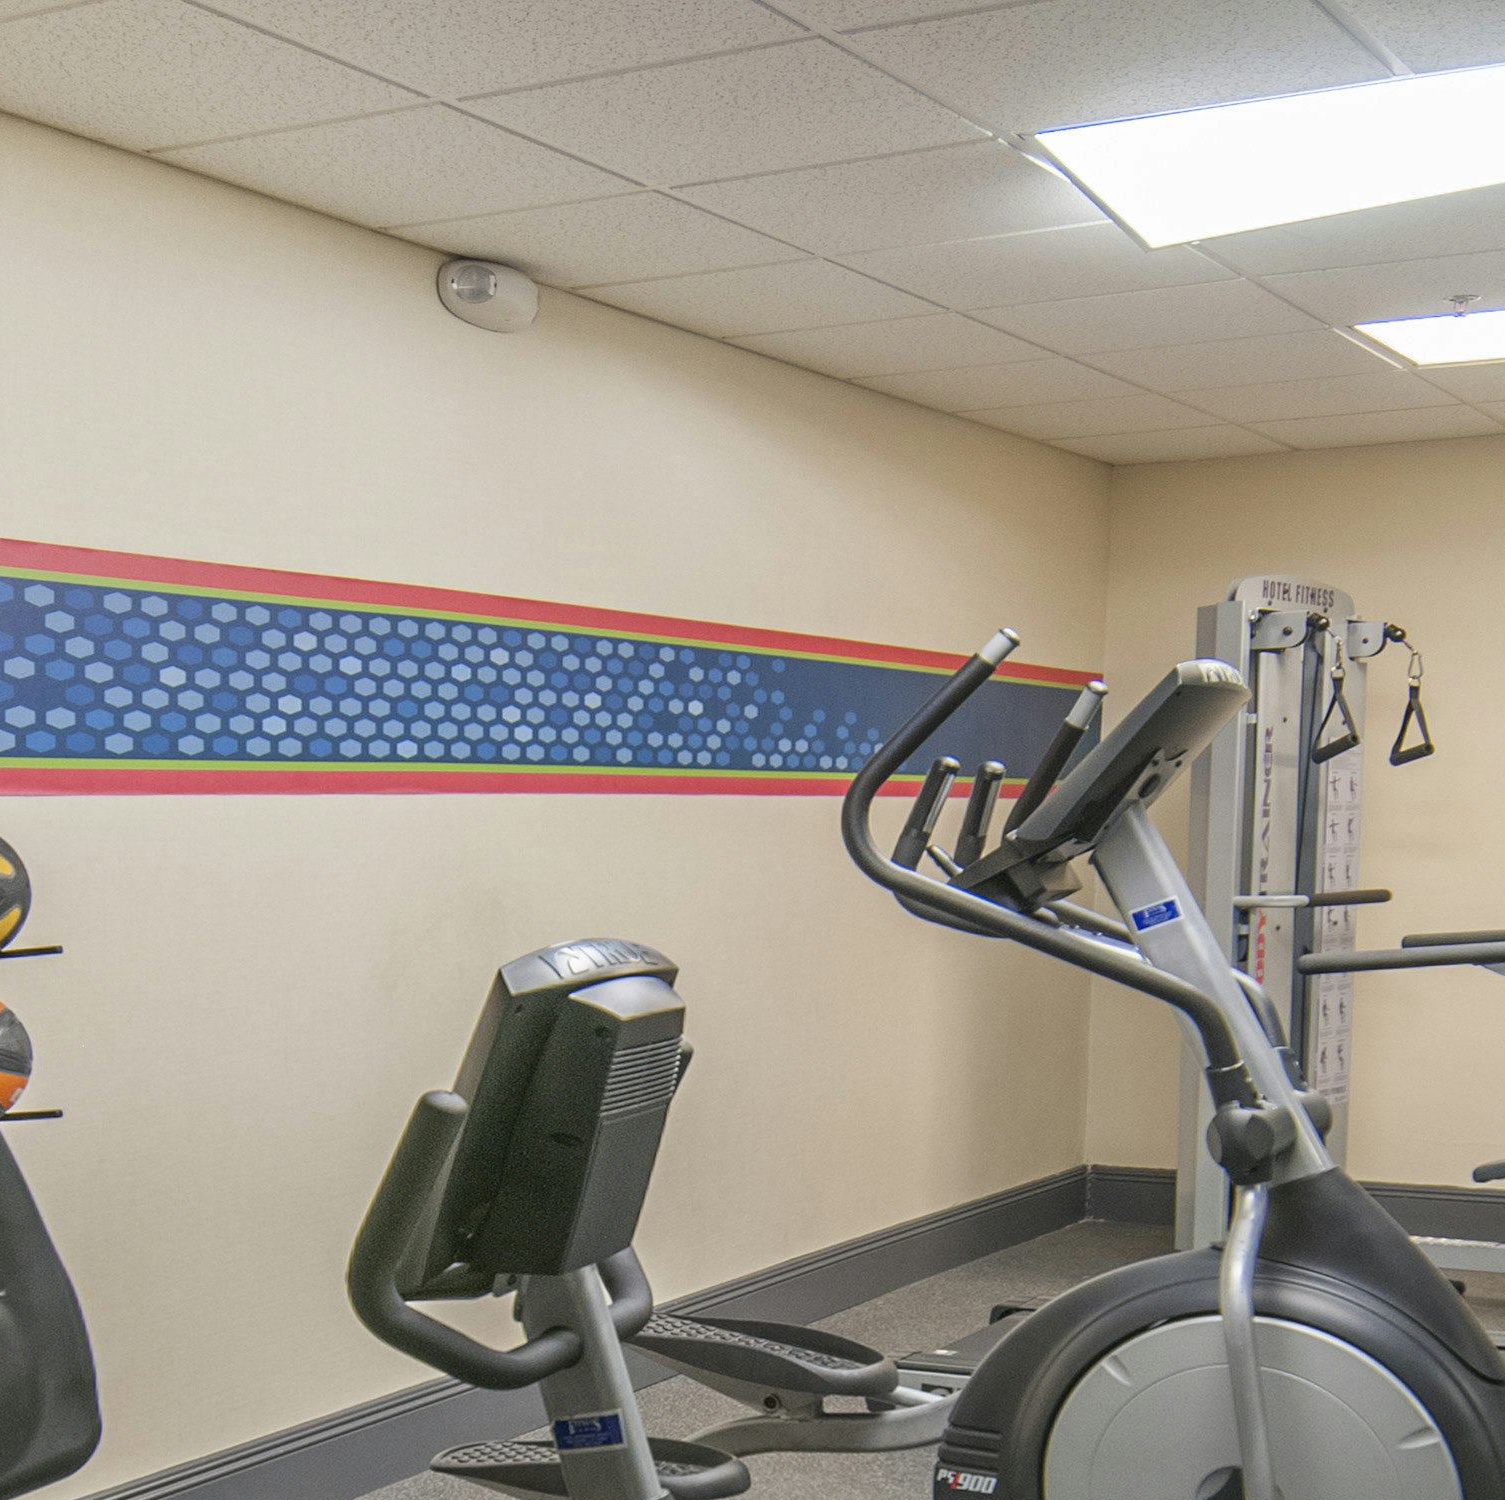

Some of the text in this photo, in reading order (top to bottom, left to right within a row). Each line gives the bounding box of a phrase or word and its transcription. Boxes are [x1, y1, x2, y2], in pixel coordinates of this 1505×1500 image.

[1261, 580, 1335, 608] HOTEL FITNESS
[1256, 907, 1267, 985] ODY
